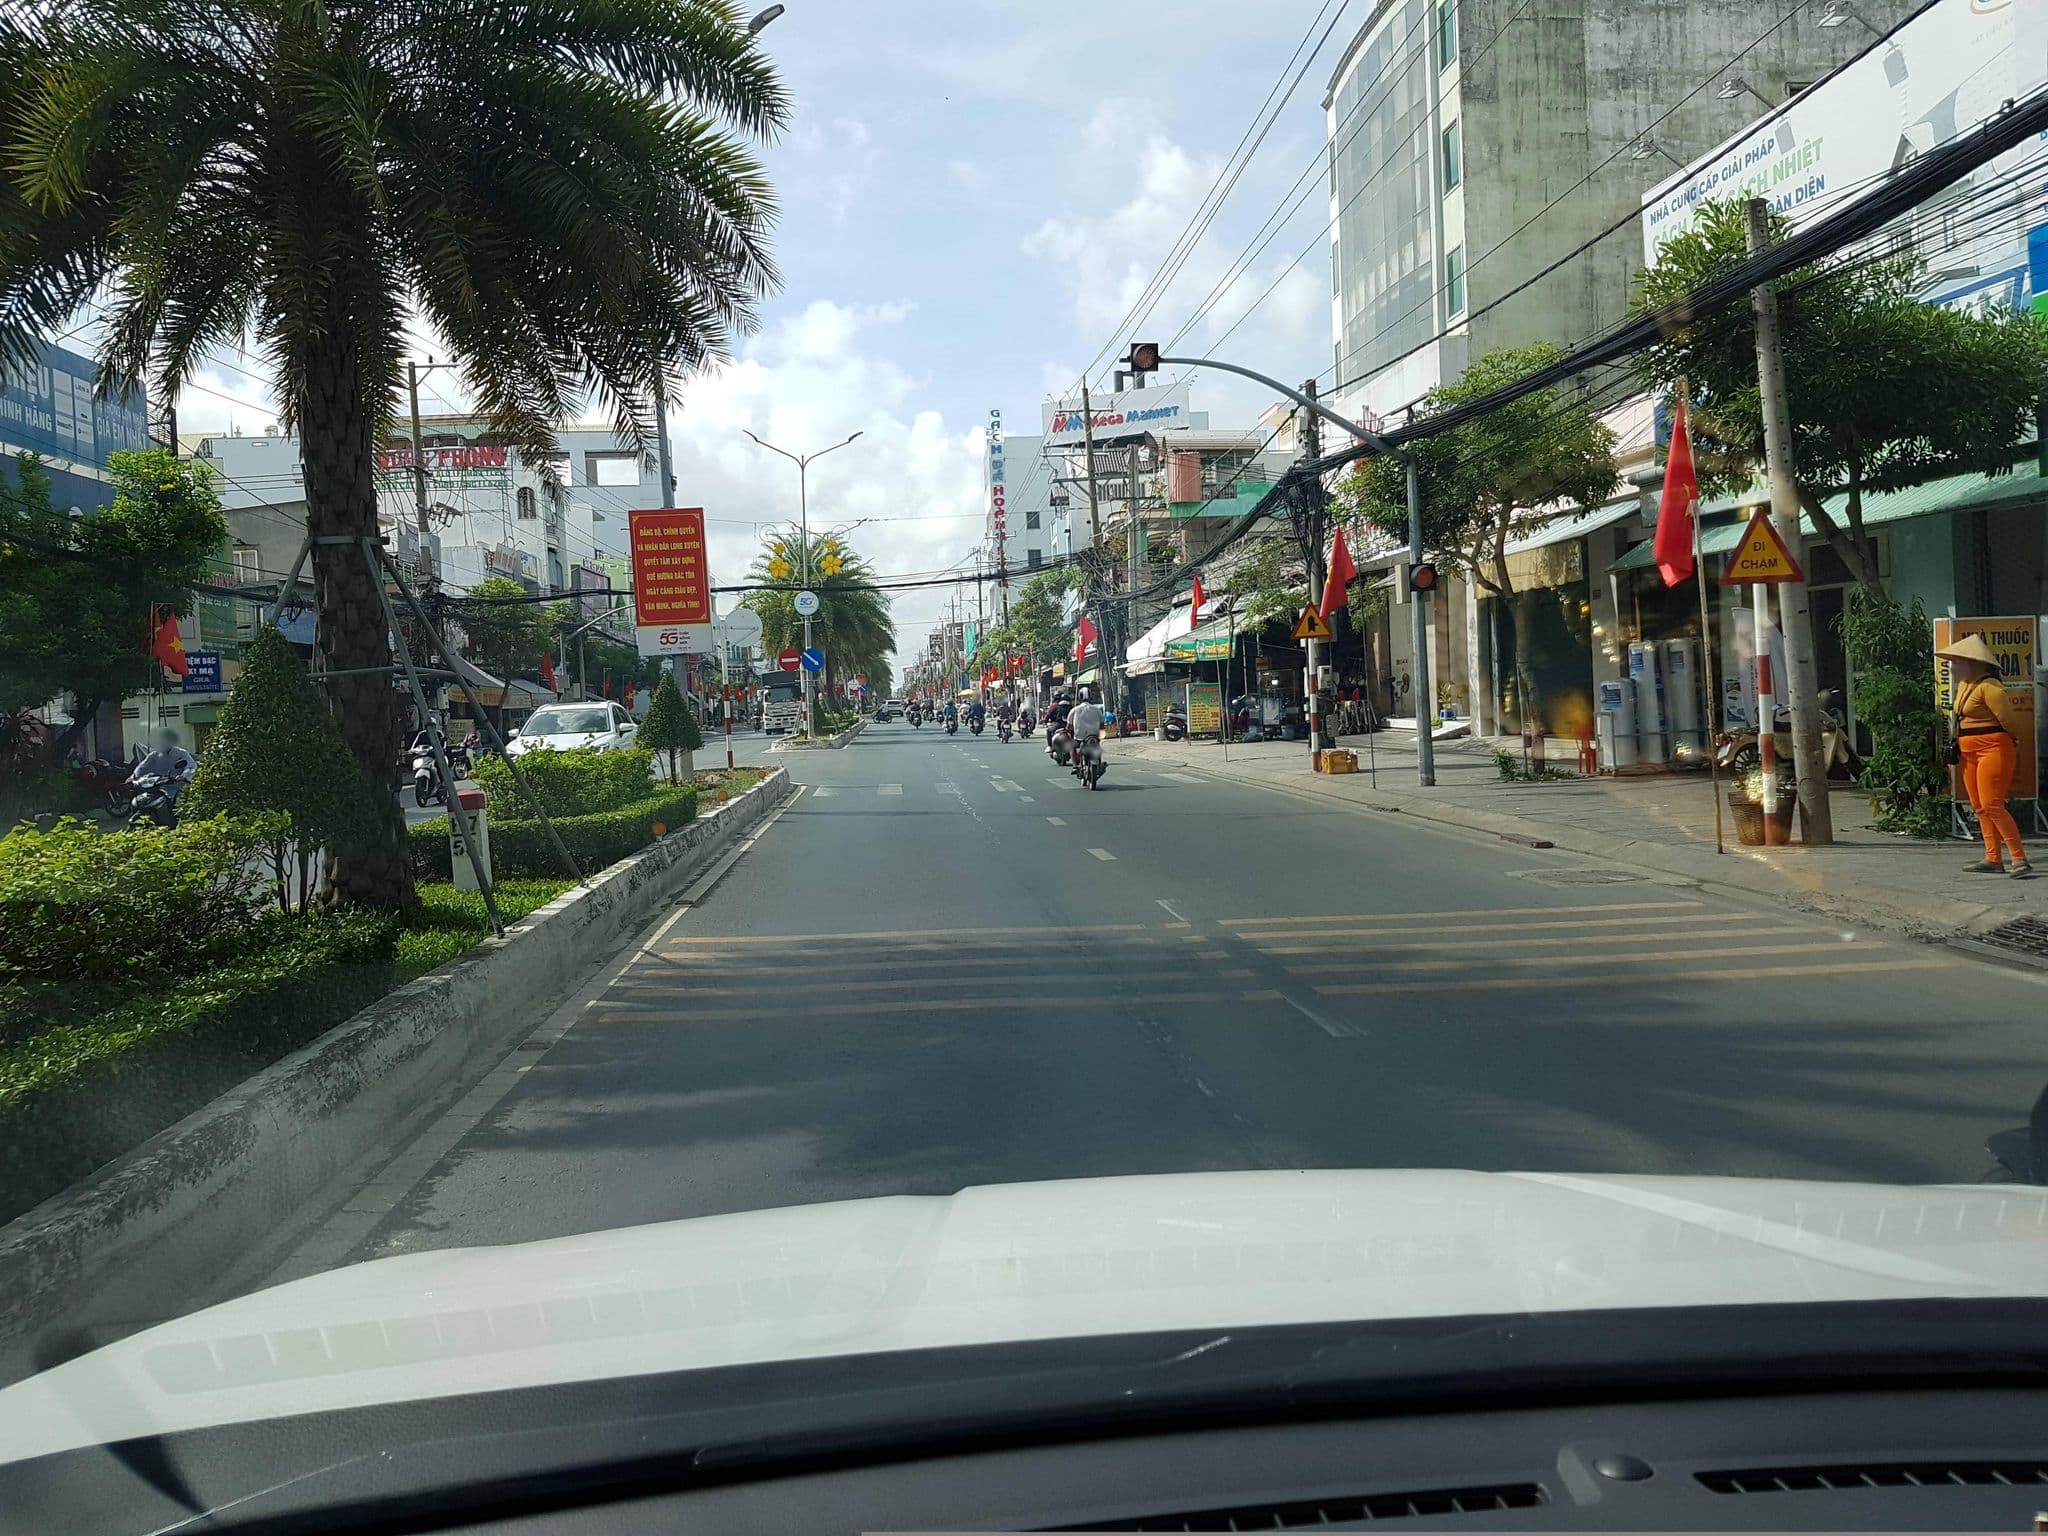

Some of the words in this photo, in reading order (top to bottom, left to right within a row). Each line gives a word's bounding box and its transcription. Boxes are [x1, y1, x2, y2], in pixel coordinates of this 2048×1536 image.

[1772, 136, 1823, 185] NHIỆT
[1650, 208, 1670, 226] NHÀ
[1671, 185, 1697, 213] CUNG
[1699, 170, 1719, 196] CẤP
[1721, 156, 1742, 182] GIẢI
[1744, 138, 1775, 169] PHÁP
[1795, 173, 1825, 205] DIỆN
[670, 542, 684, 550] LONG
[1753, 541, 1766, 552] ĐI
[660, 632, 678, 645] 5G
[1990, 626, 2030, 646] THUỐC
